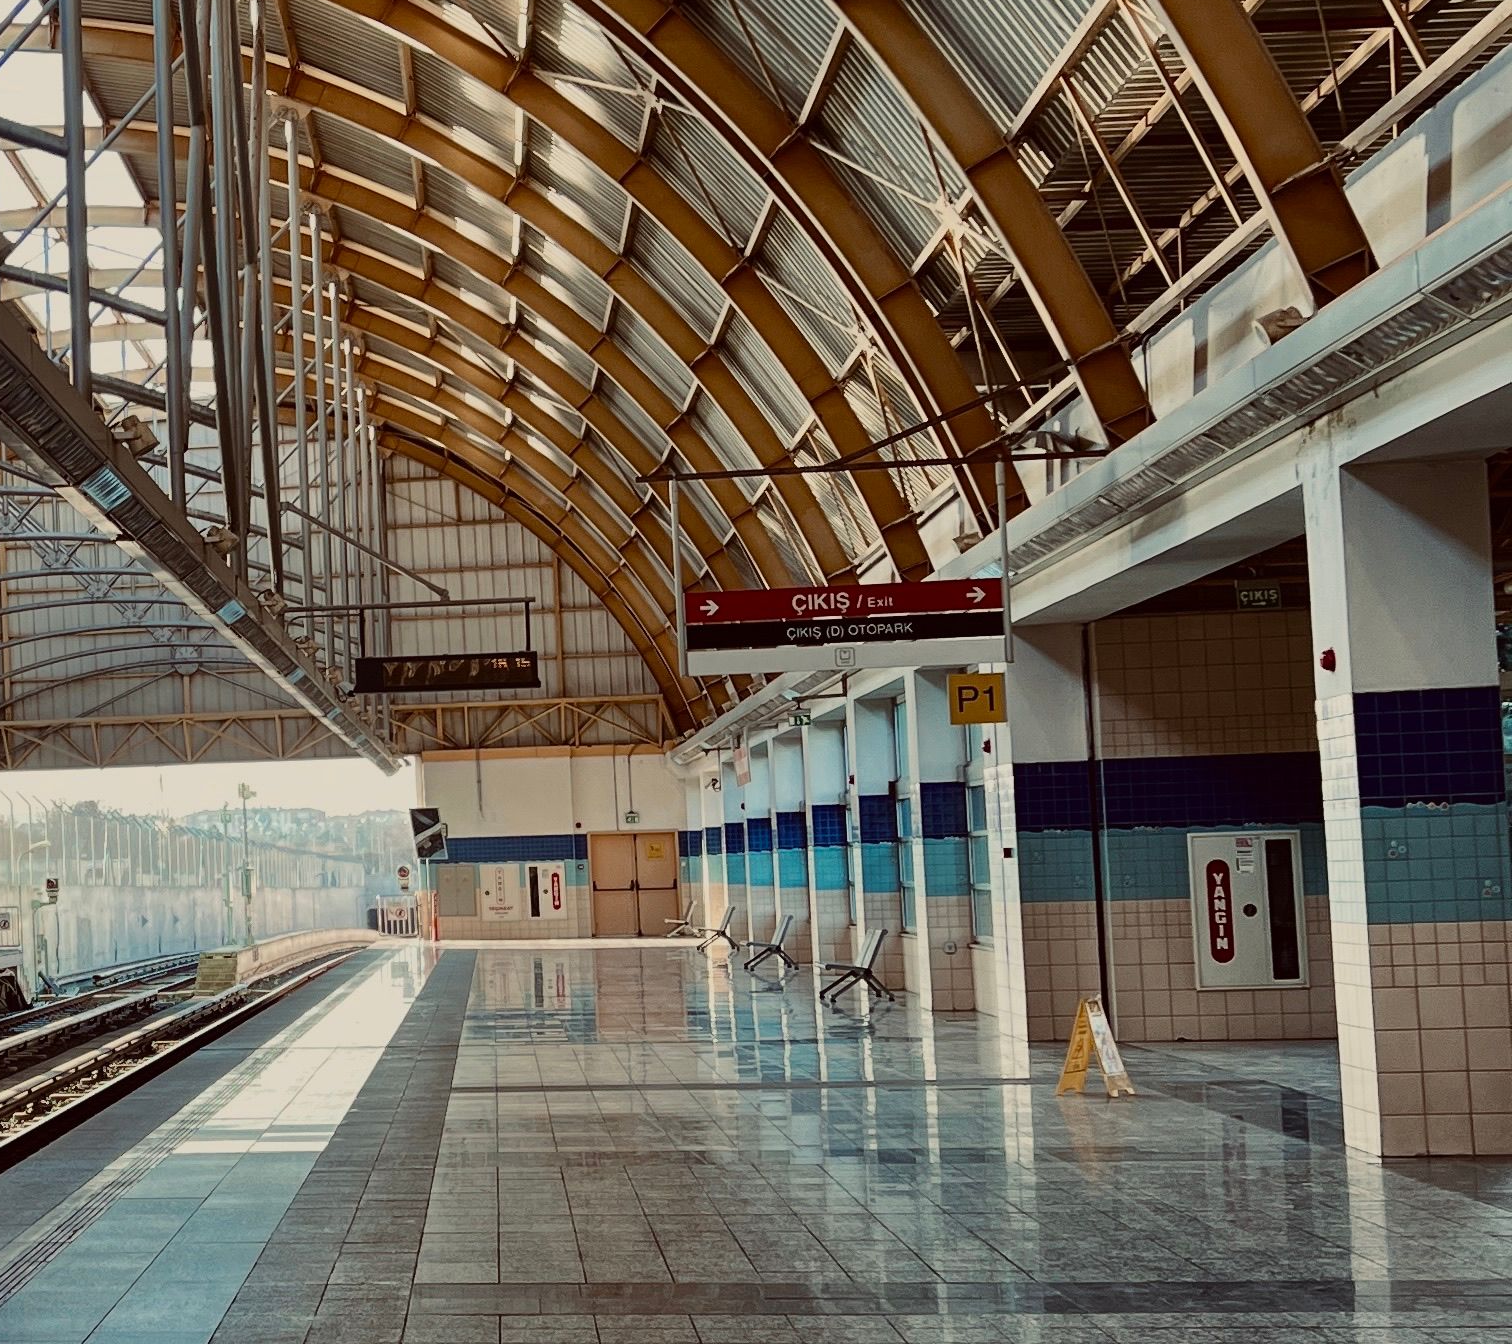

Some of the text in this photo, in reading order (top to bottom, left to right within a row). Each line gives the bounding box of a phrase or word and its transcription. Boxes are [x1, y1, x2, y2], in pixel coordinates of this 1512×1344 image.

[791, 591, 850, 616] ÇIKIŞ
[867, 595, 894, 608] Exit
[1240, 589, 1278, 605] ÇIKIŞ
[786, 622, 914, 641] ÇIKIŞ (D) OTOPARK
[957, 685, 995, 713] P1
[1212, 872, 1229, 950] YANGIN
